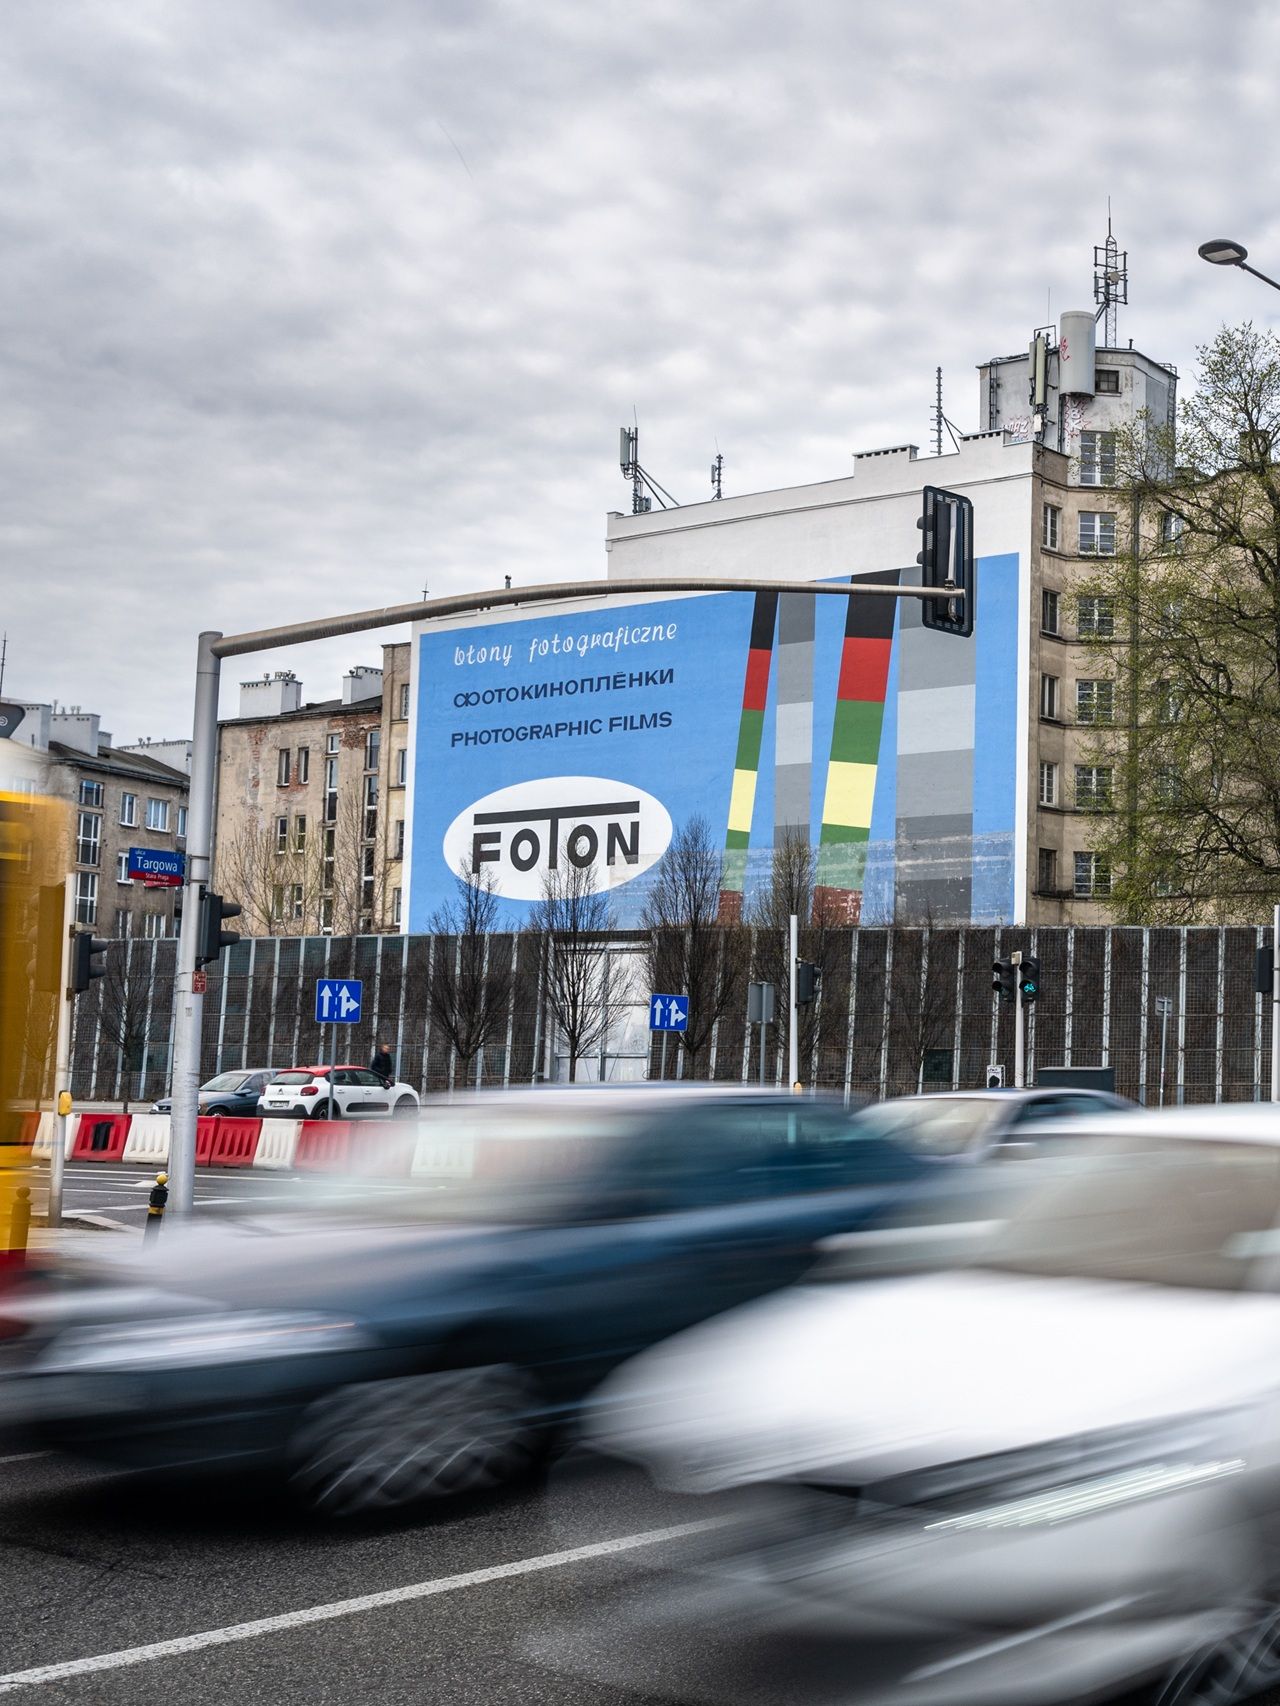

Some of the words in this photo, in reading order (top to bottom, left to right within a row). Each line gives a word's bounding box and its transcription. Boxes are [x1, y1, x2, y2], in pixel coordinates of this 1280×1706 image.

[454, 644, 513, 667] błony
[528, 622, 678, 663] fotograficzne
[453, 668, 675, 708] ФОТОКИНОПЛЁНКИ
[450, 718, 603, 748] PHOTOGRAPHIC
[608, 711, 673, 732] FILMS
[472, 801, 640, 874] FOTON
[136, 856, 178, 873] Targowa
